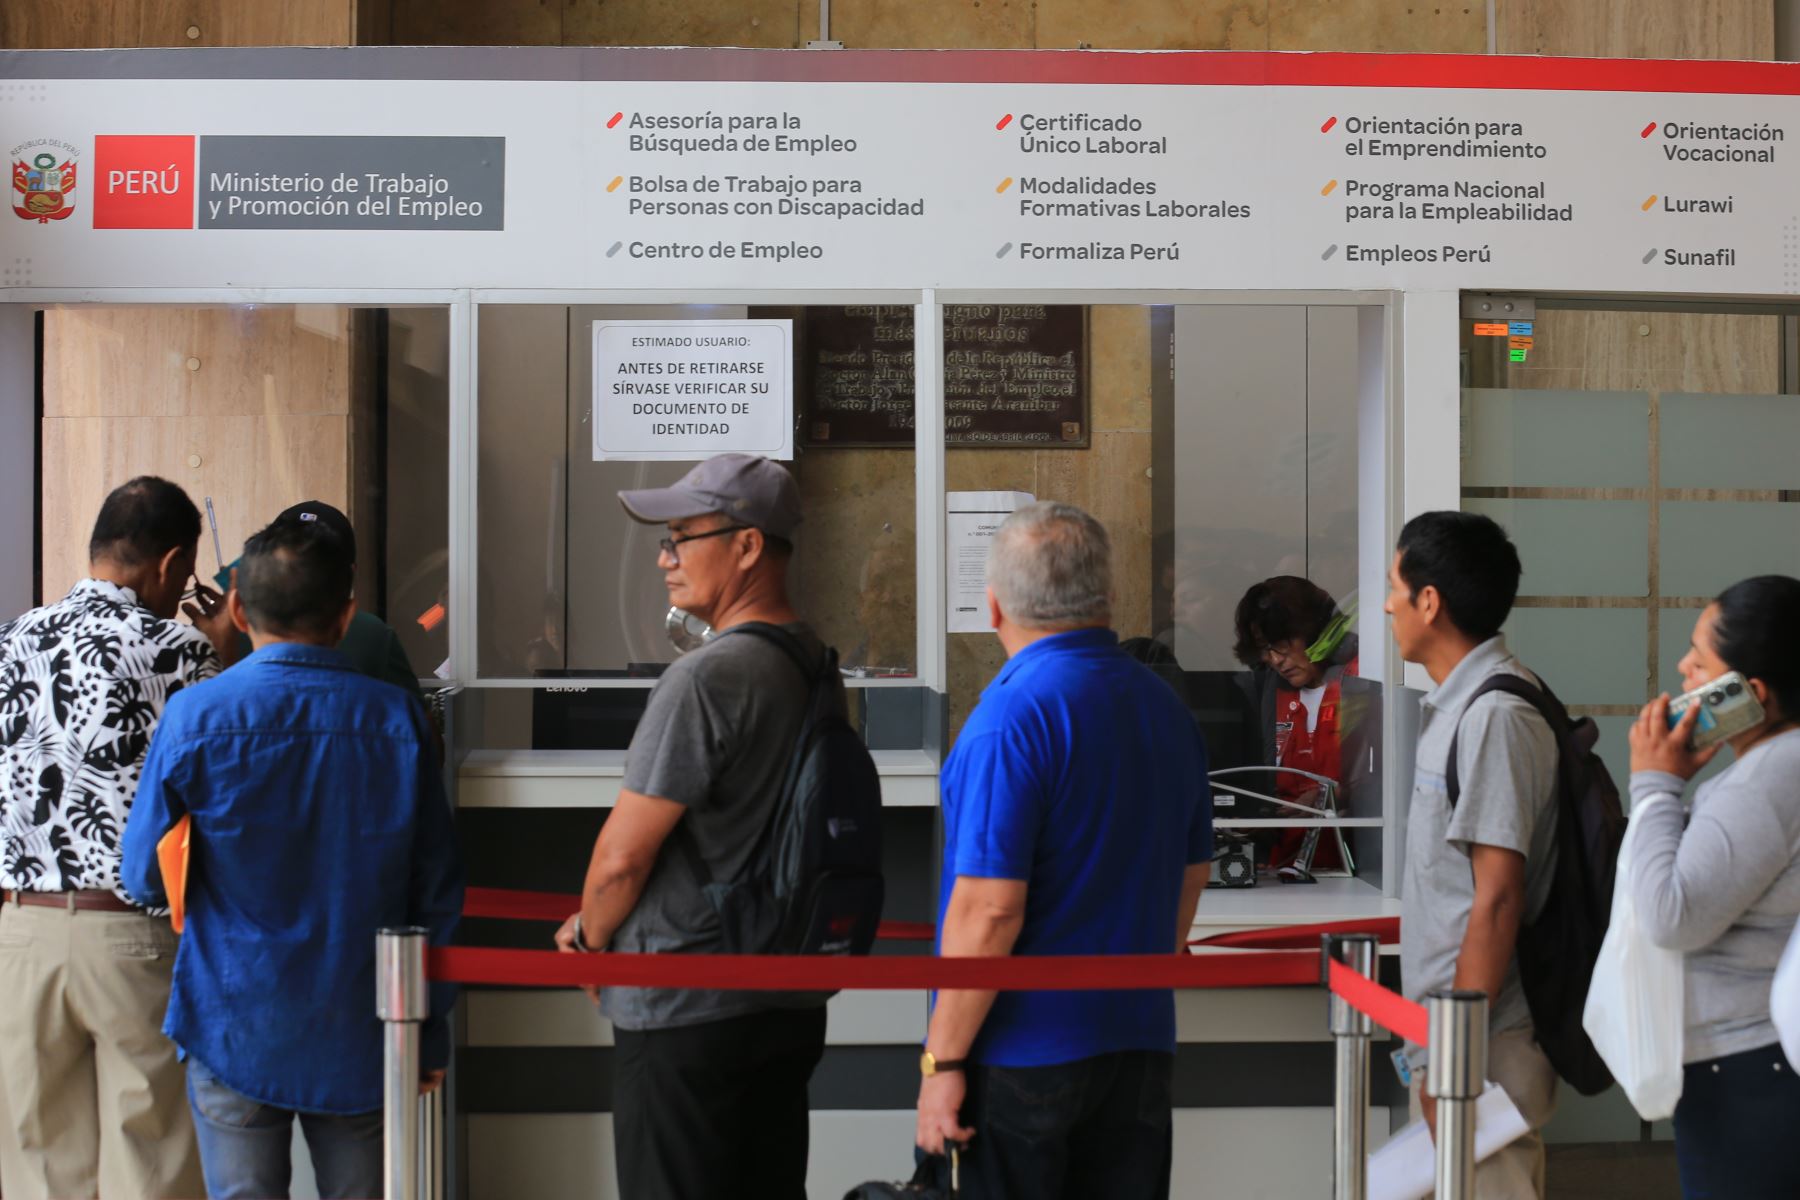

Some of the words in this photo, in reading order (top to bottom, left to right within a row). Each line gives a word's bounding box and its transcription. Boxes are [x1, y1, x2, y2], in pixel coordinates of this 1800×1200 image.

[628, 111, 722, 129] Asesoría
[728, 117, 777, 133] para
[783, 112, 800, 129] la
[1019, 113, 1141, 132] Certificado
[1345, 116, 1469, 134] Orientación
[1475, 123, 1522, 139] para
[1663, 122, 1783, 141] Orientación
[629, 132, 737, 155] Búsqueda
[742, 134, 769, 151] de
[775, 135, 856, 156] Empleo
[1020, 131, 1080, 153] Único
[1086, 136, 1166, 153] Laboral
[1345, 139, 1362, 155] el
[1368, 140, 1546, 160] Emprendimiento
[1663, 145, 1774, 162] Vocacional
[108, 164, 179, 194] PERÚ
[210, 173, 323, 192] Ministerio
[331, 173, 358, 192] de
[364, 173, 448, 197] Trabajo
[629, 175, 687, 192] Bolsa
[692, 175, 719, 192] de
[724, 175, 807, 197] Trabajo
[812, 180, 861, 197] para
[1020, 177, 1156, 194] Modalidades
[1346, 180, 1448, 201] Programa
[1454, 181, 1544, 198] Nacional
[208, 201, 221, 219] y
[228, 195, 348, 215] Promoción
[356, 196, 390, 215] del
[398, 196, 482, 220] Empleo
[629, 199, 728, 215] Personas
[733, 203, 772, 215] con
[778, 198, 923, 219] Discapacidad
[1020, 199, 1140, 216] Formativas
[1145, 200, 1250, 217] Laborales
[1346, 206, 1393, 222] para
[1399, 202, 1416, 219] la
[1422, 203, 1572, 223] Empleabilidad
[1664, 196, 1732, 213] Lurawi
[628, 242, 703, 258] Centro
[708, 241, 735, 258] de
[741, 241, 822, 262] Empleo
[1020, 242, 1124, 259] Formaliza
[1130, 242, 1179, 260] Perú
[1346, 245, 1437, 265] Empleos
[1442, 245, 1490, 262] Perú
[1664, 249, 1735, 265] Sunafil
[632, 338, 691, 346] ESTIMADO
[695, 337, 750, 346] USUARIO:
[943, 326, 1029, 343] eruanos
[617, 363, 662, 374] ANTES
[667, 363, 684, 374] DE
[690, 363, 764, 374] RETIRARSE
[612, 381, 669, 394] SÍRVASE
[674, 383, 746, 394] VERIFICAR
[750, 383, 768, 393] SU
[632, 403, 726, 414] DOCUMENTO
[731, 403, 748, 414] DE
[652, 424, 729, 434] IDENTIDAD
